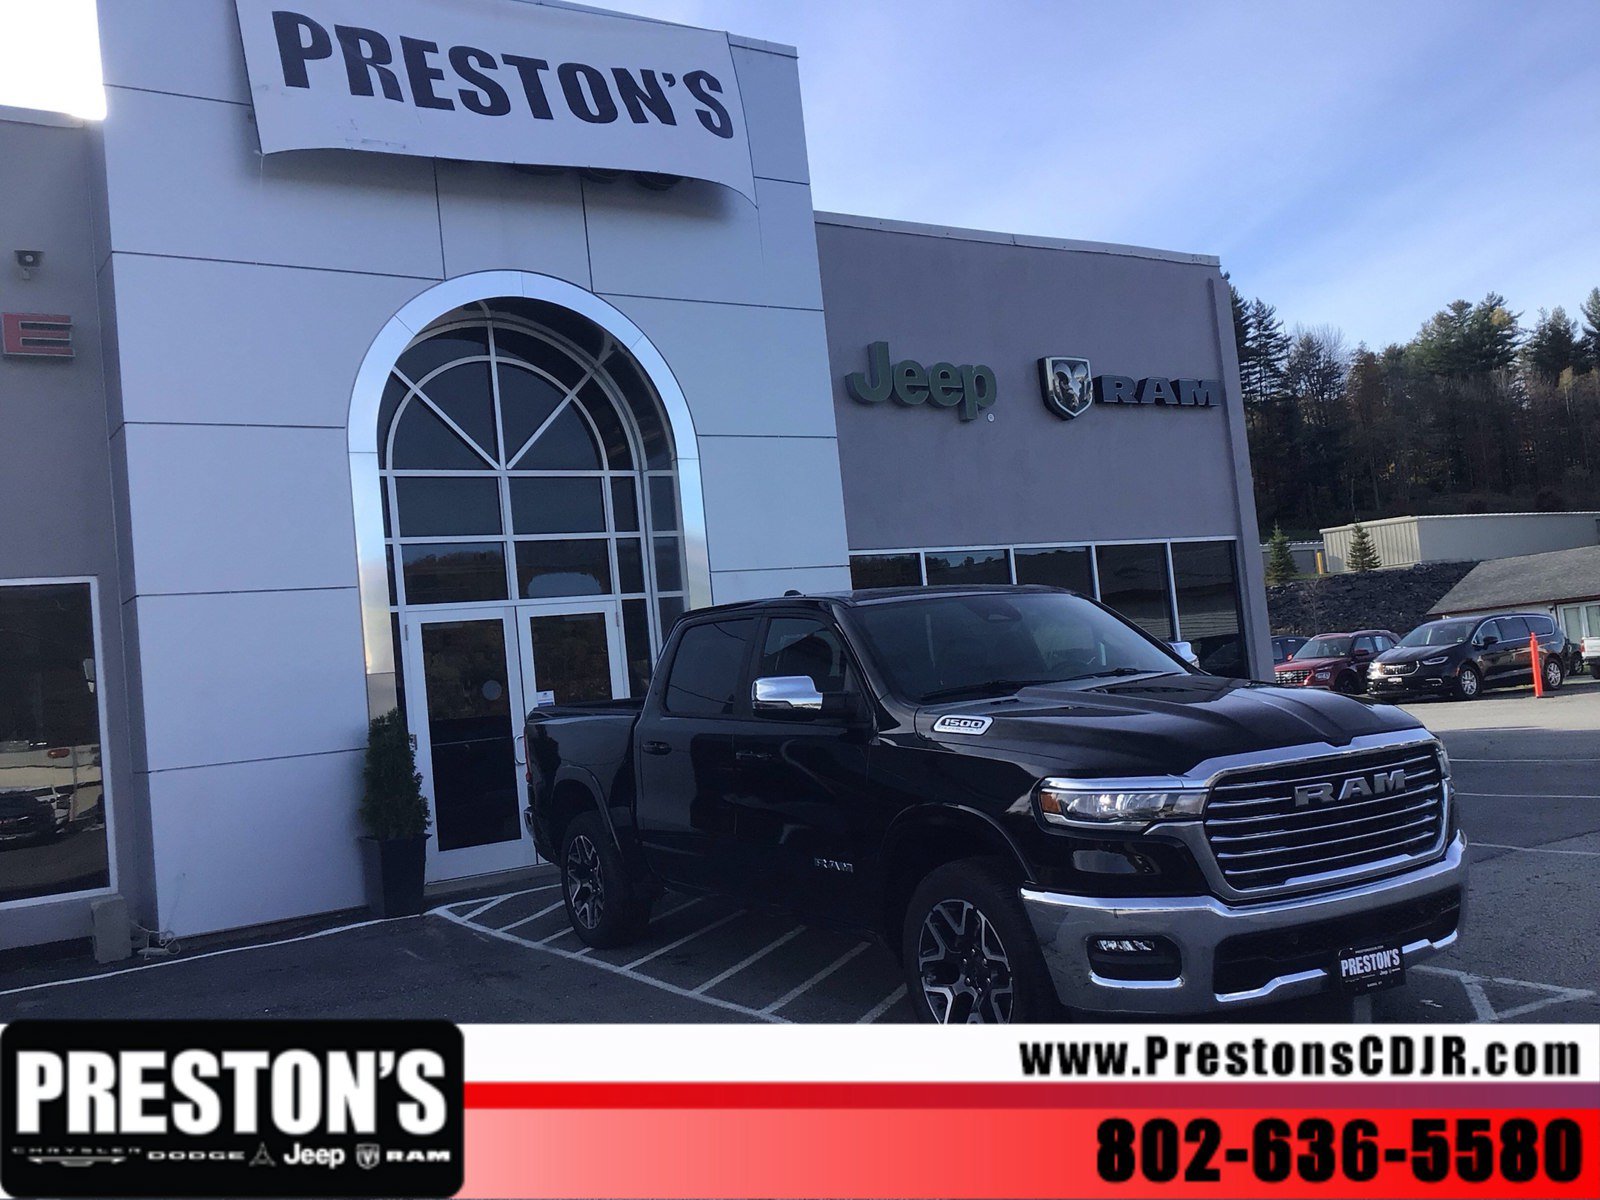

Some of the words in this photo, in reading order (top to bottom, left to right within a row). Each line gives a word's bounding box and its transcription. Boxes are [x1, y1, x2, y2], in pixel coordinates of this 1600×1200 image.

[272, 11, 734, 139] PRESTON'S
[2, 313, 74, 358] E
[846, 341, 998, 422] Jeep
[1094, 375, 1222, 406] RAM
[944, 718, 983, 728] 1500
[1294, 768, 1406, 807] RAM
[814, 857, 854, 873] RAM
[1340, 948, 1400, 978] PRESTON'S
